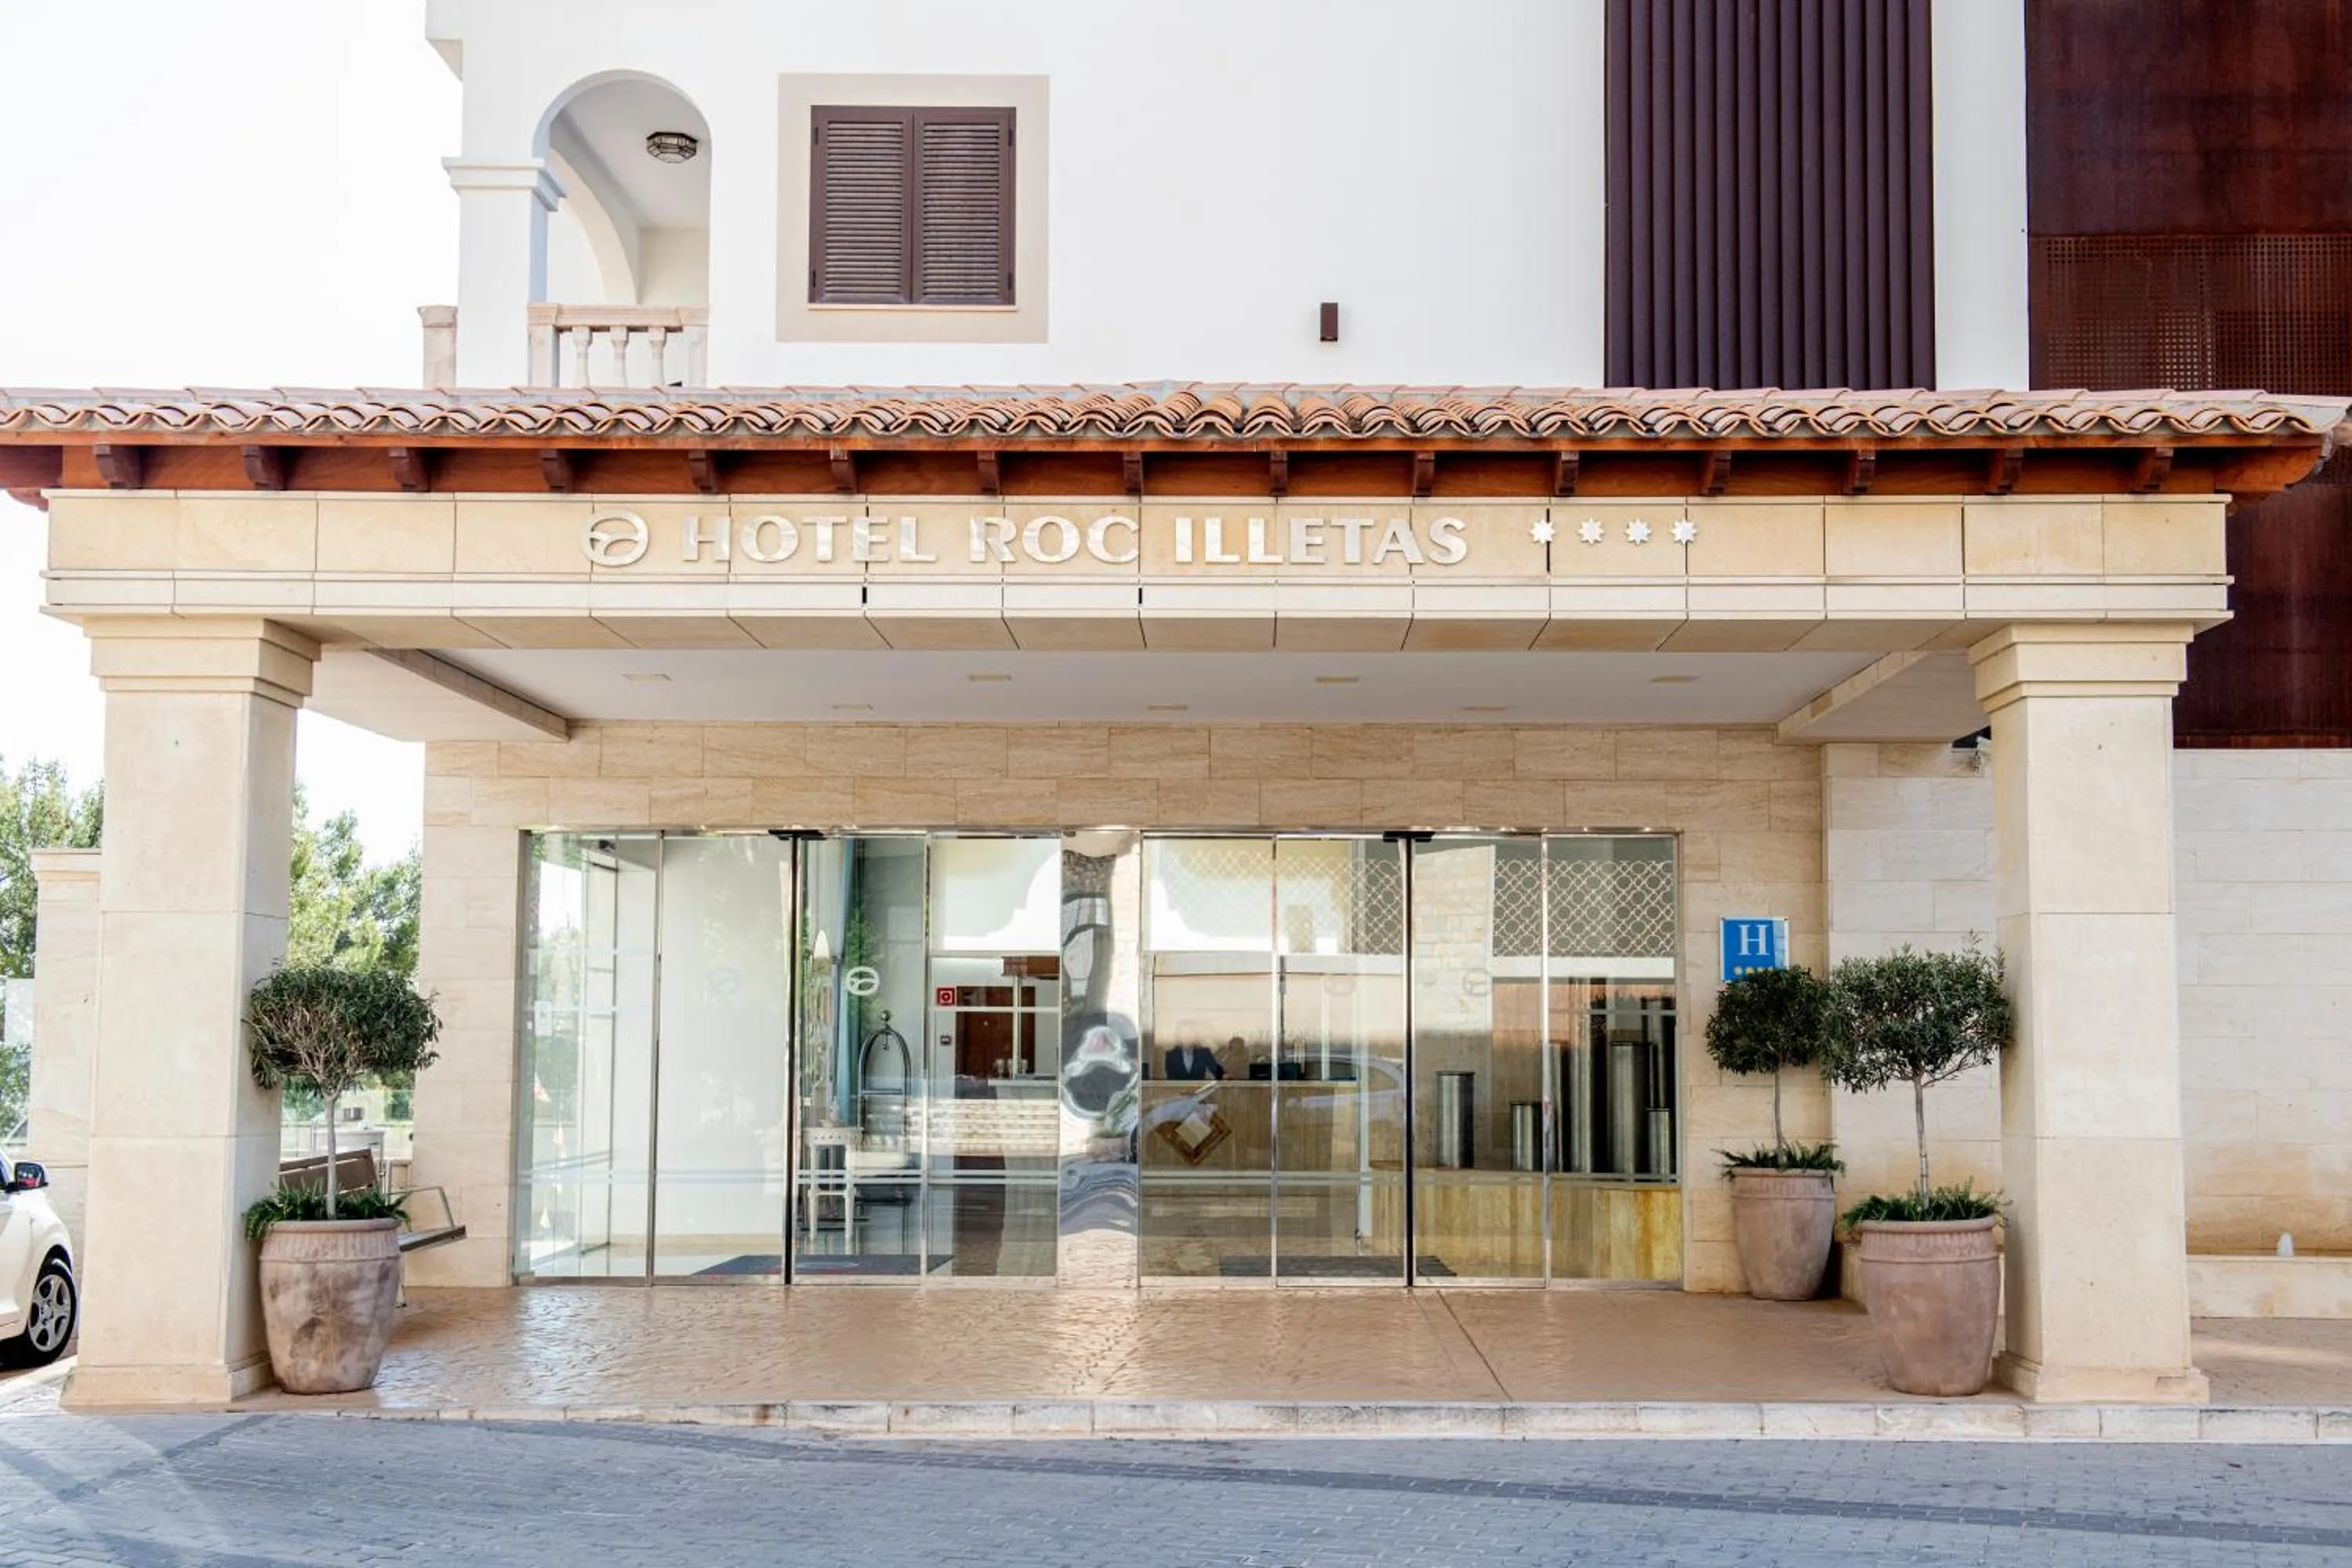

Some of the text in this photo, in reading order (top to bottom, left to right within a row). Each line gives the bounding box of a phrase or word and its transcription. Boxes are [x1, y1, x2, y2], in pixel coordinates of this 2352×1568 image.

[683, 515, 1467, 564] HOTEL ROC ILLETAS
[1737, 924, 1769, 956] H
